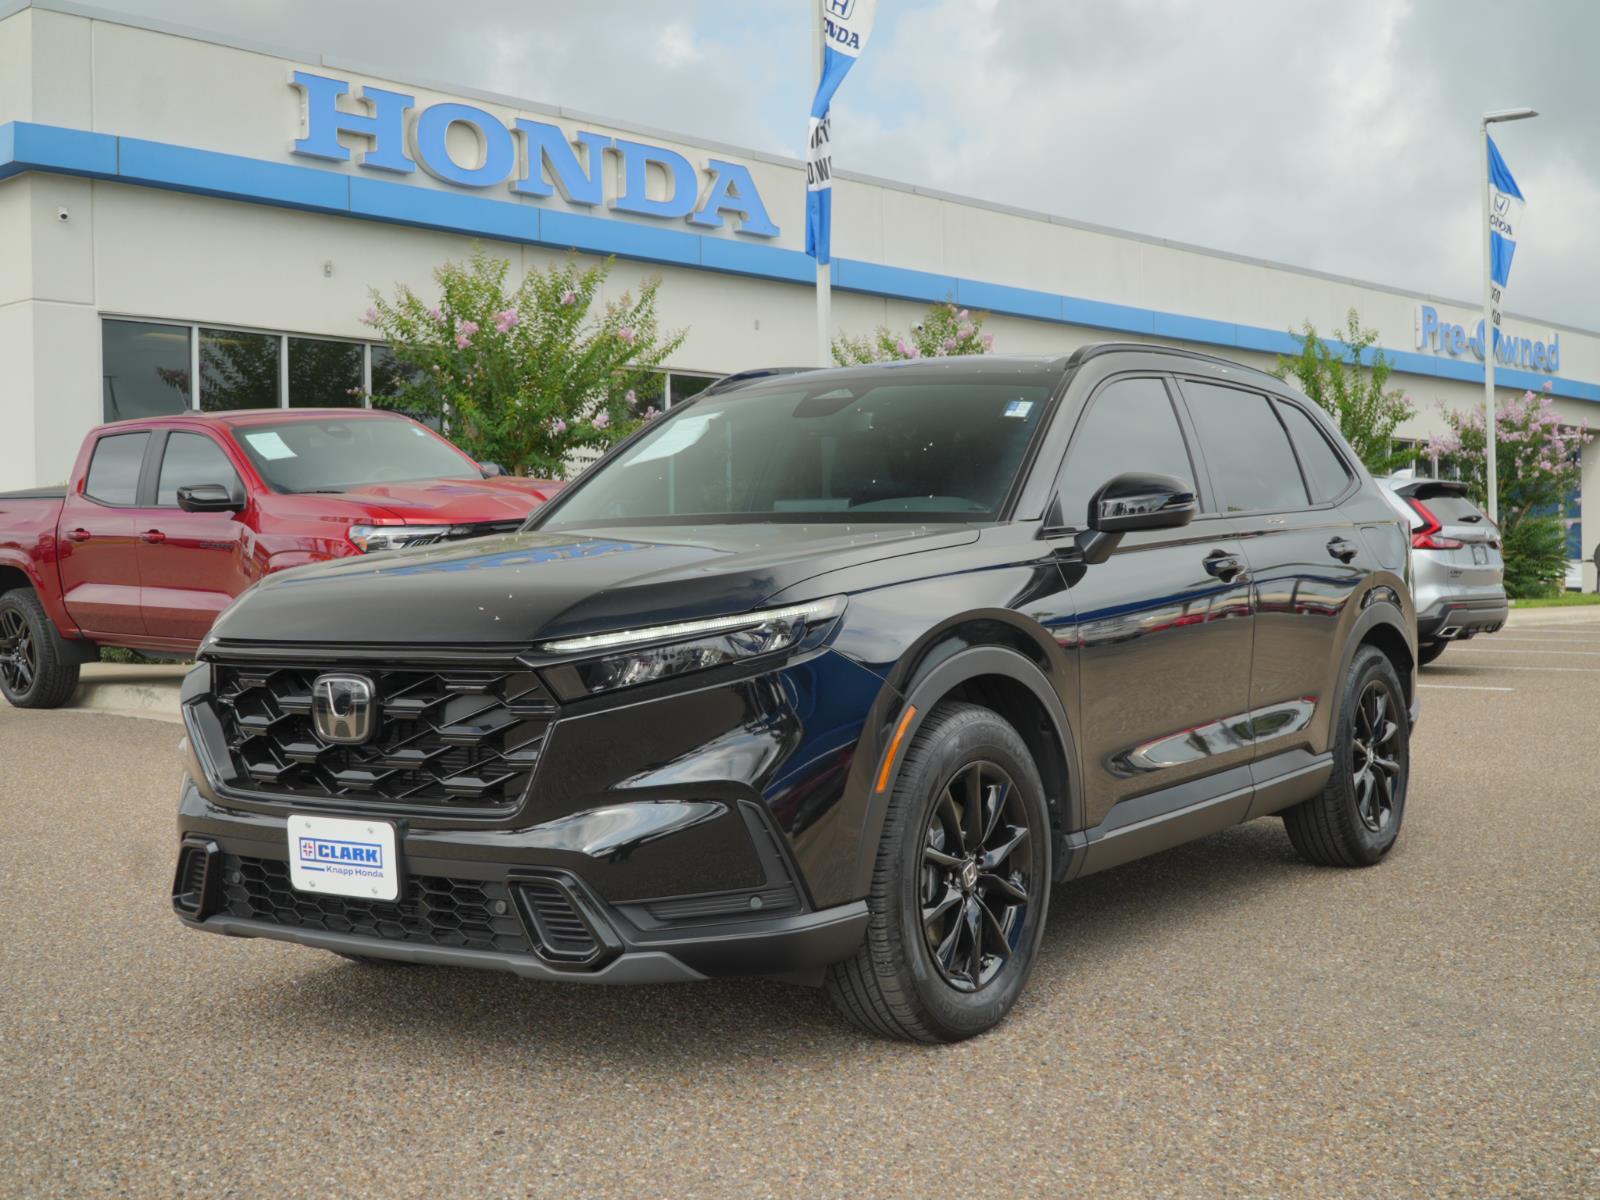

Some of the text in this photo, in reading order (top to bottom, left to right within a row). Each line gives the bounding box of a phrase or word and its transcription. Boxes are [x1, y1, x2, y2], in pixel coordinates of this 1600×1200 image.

[290, 71, 779, 238] HONDA
[318, 844, 378, 863] CLARK
[326, 866, 384, 878] Knapp Honda
